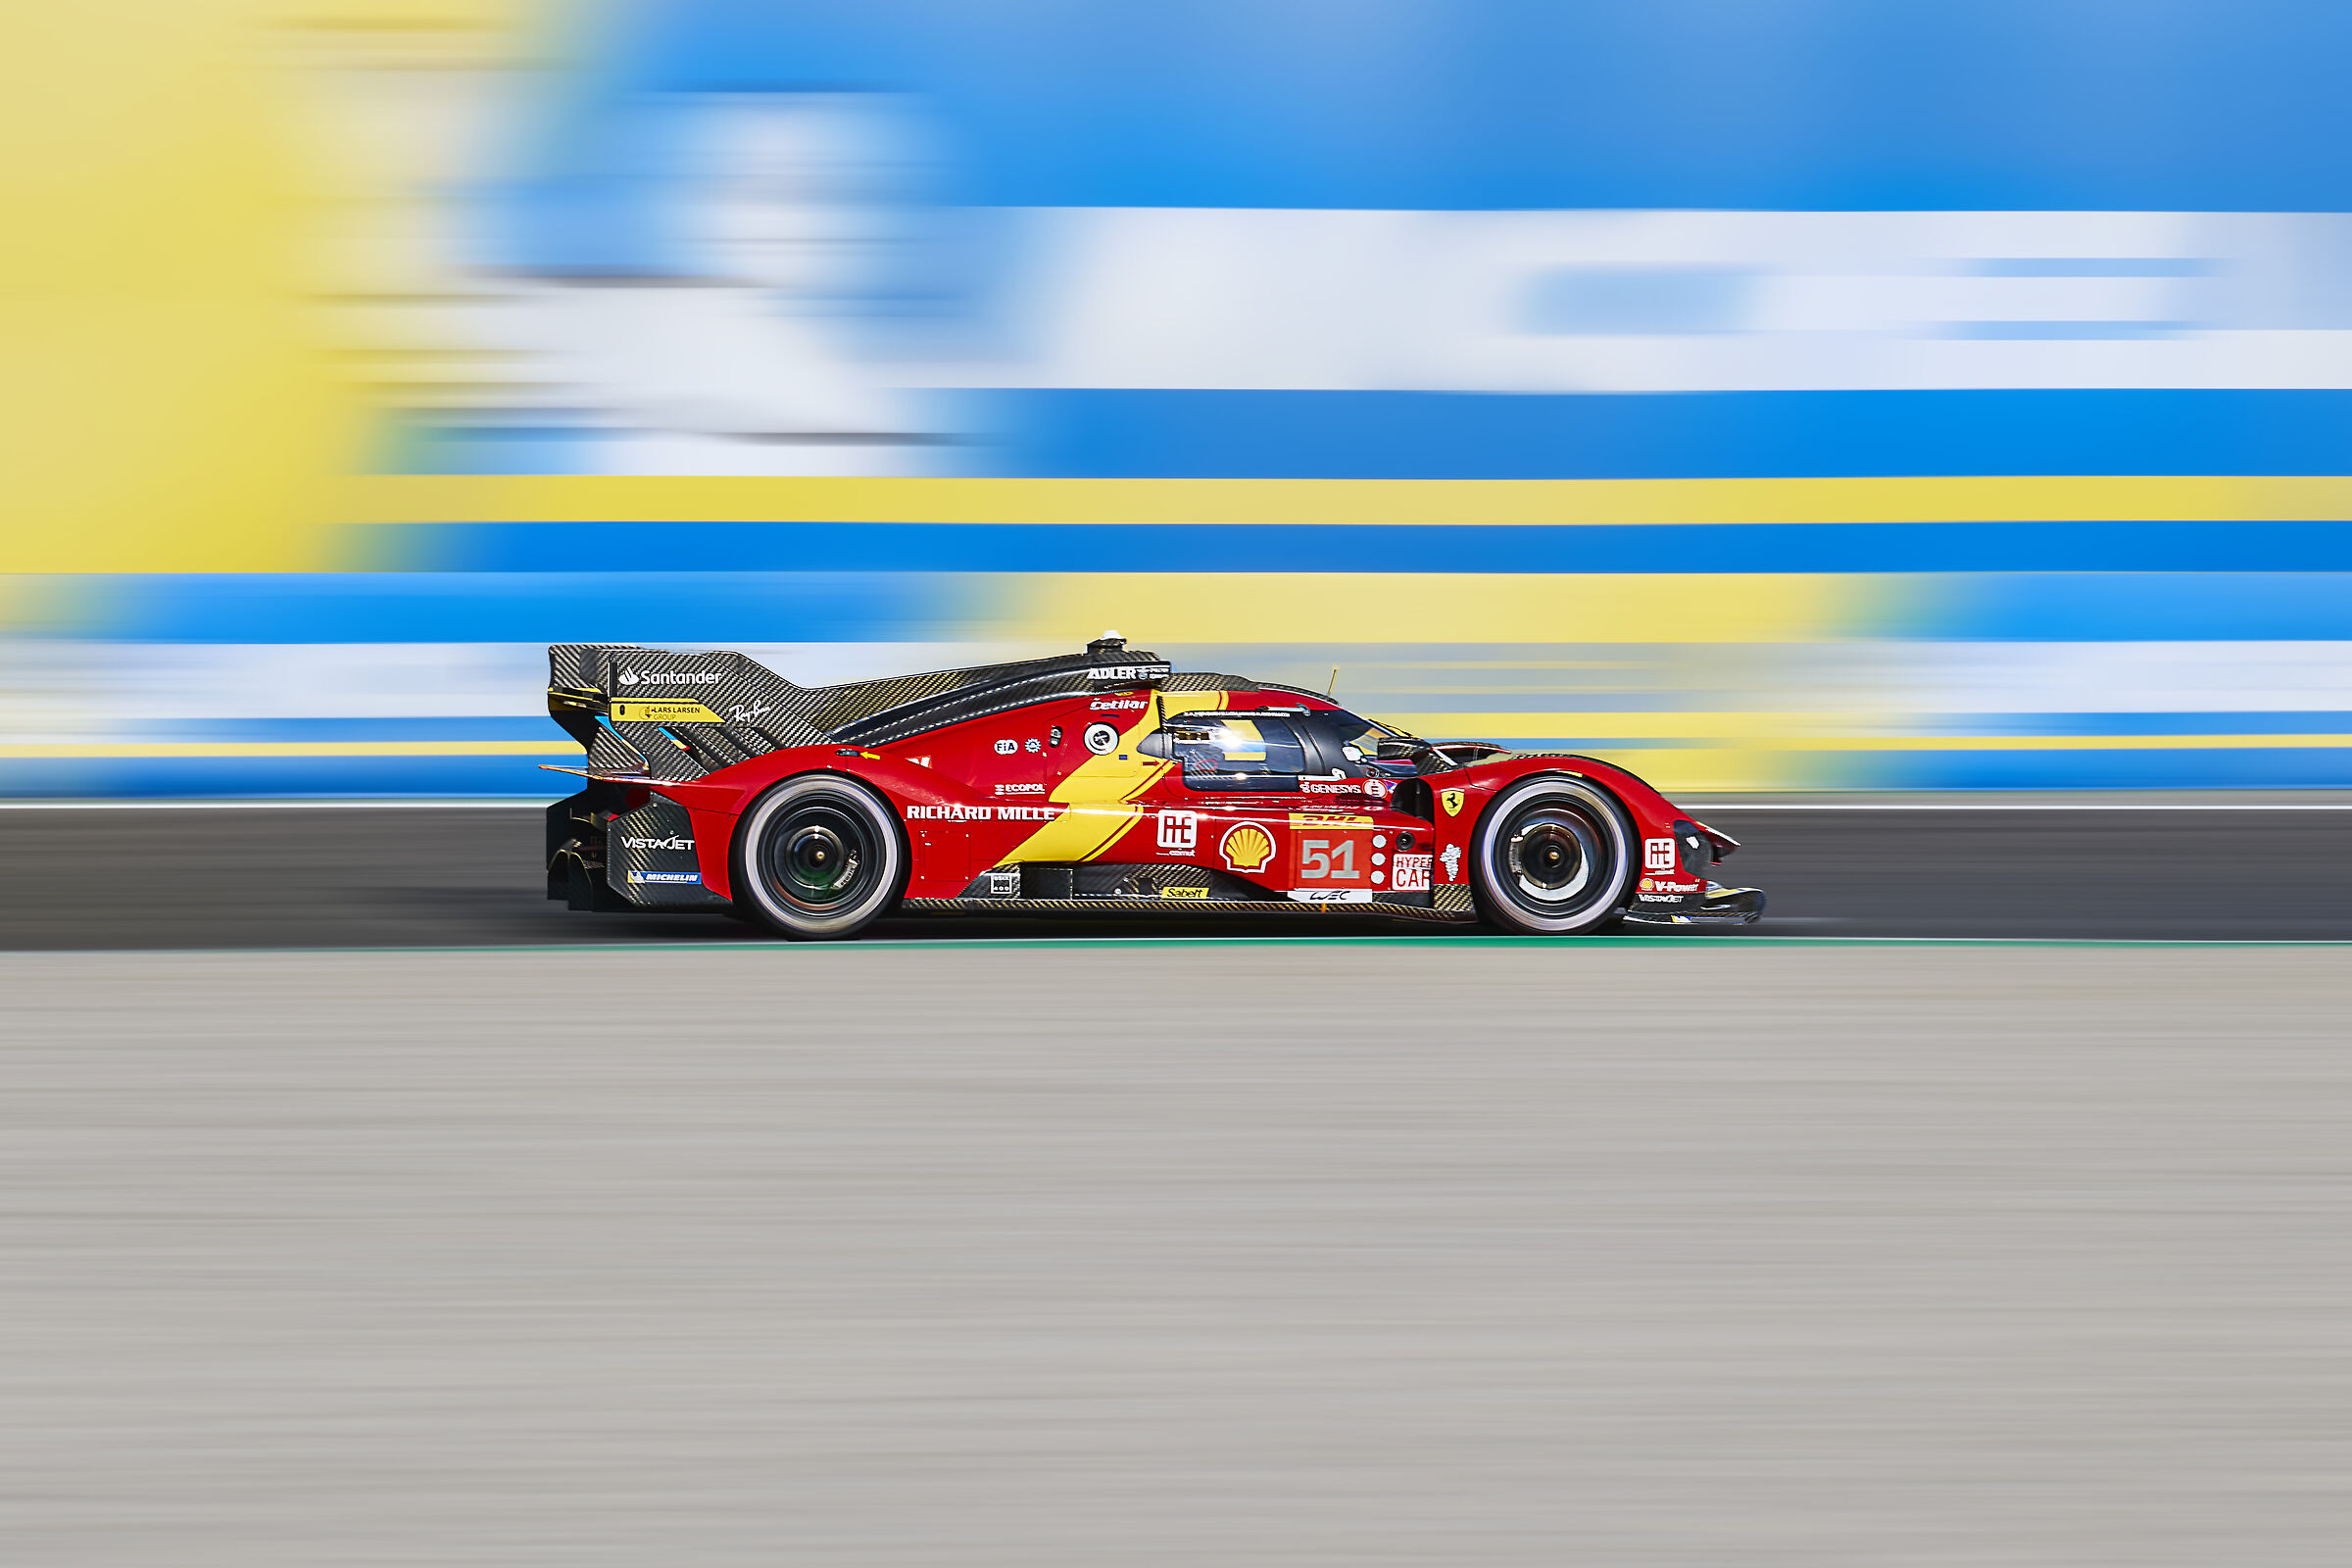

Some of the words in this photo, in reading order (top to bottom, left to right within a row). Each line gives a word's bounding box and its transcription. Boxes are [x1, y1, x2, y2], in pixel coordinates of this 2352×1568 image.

[641, 670, 721, 685] Santander
[1087, 667, 1137, 680] ADLER
[1090, 699, 1149, 710] Cetilar
[1004, 783, 1046, 792] ECOPOL
[1310, 784, 1362, 794] GENESYS
[906, 804, 992, 821] RICHARD
[998, 806, 1055, 821] MILLE
[1300, 839, 1360, 879] 51
[645, 873, 699, 882] MICHELIN
[1309, 890, 1351, 901] WEC
